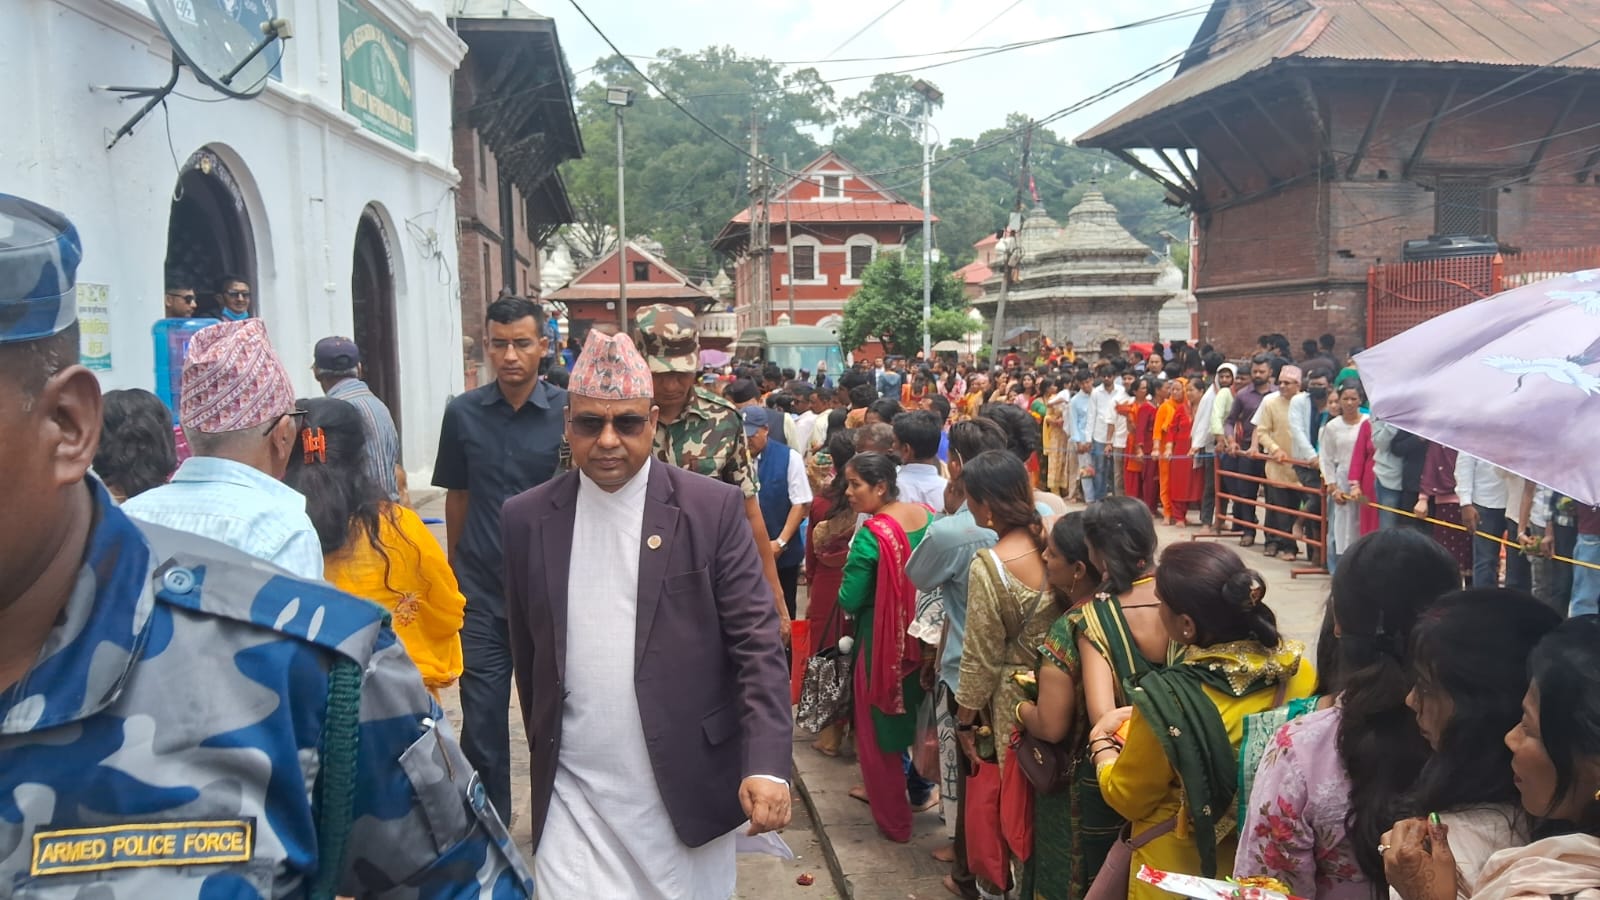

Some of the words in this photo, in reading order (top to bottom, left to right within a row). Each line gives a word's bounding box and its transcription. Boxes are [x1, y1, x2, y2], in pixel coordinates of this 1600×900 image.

[39, 839, 107, 864] ARMED
[112, 834, 176, 857] POLICE
[184, 831, 244, 853] FORCE
